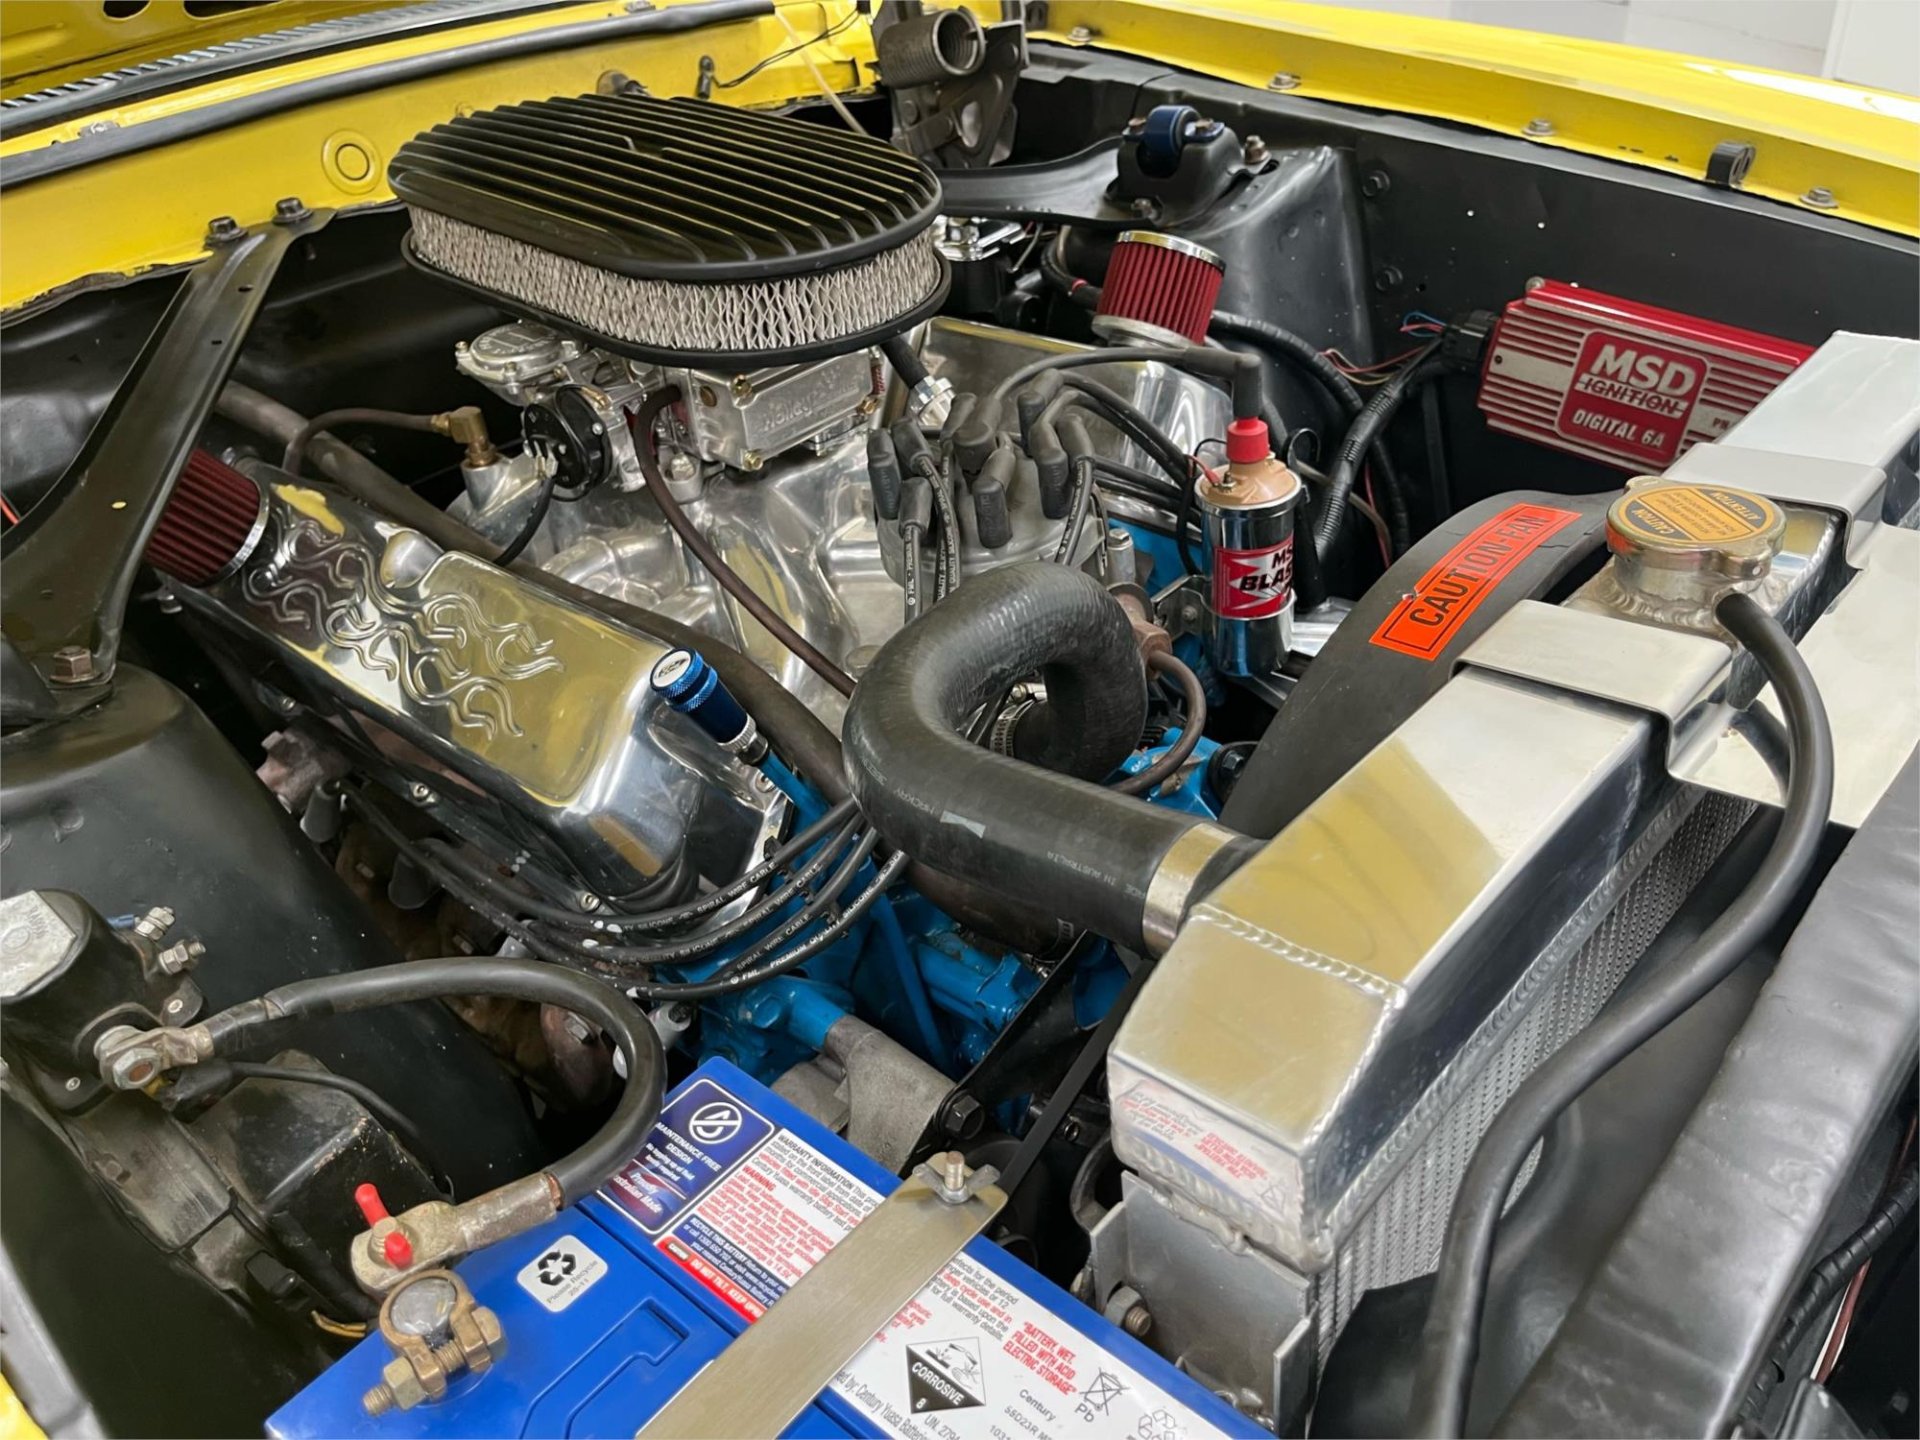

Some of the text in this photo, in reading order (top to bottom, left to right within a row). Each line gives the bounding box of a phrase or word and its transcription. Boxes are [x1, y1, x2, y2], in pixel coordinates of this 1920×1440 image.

[1590, 343, 1696, 397] MSD
[1582, 376, 1681, 416] IGNITION
[1572, 408, 1665, 449] DIGITAL 6A
[1631, 508, 1675, 535] CAUTION
[1408, 515, 1551, 627] CAUTION-FAN
[796, 861, 823, 887] CABLE
[1046, 851, 1103, 878] AUSTRALIA
[697, 896, 725, 913] SPIRAL
[727, 880, 748, 896] WIRE
[749, 860, 778, 884] CABLE
[736, 949, 763, 971] SPIRAL
[785, 913, 812, 935] CABLE
[742, 969, 761, 981] FML
[770, 944, 807, 969] PREMIUM
[842, 885, 875, 918] SILICONE
[655, 1122, 721, 1172] MAINTENANCE FREE
[665, 1143, 693, 1164] DESIGN
[776, 1133, 867, 1200] WARRANTY INFORMATION This
[733, 1172, 750, 1185] Lead
[741, 1164, 776, 1191] WARNING
[763, 1145, 787, 1163] months
[783, 1160, 795, 1169] for
[792, 1166, 828, 1193] commercial
[786, 1152, 798, 1161] on
[794, 1157, 808, 1168] the
[804, 1164, 822, 1178] front
[818, 1174, 837, 1188] label
[833, 1184, 851, 1198] from
[848, 1195, 865, 1207] date
[612, 1174, 662, 1213] ustralian Made
[749, 1156, 775, 1176] Century
[786, 1183, 815, 1205] warranty
[811, 1201, 835, 1219] battery
[831, 1215, 847, 1228] test
[687, 1216, 780, 1288] RECYCLE THIS BATTERY Return to your
[689, 1241, 703, 1253] your
[695, 1234, 711, 1247] 1300
[688, 1258, 702, 1270] DO
[697, 1265, 715, 1280] NOT
[727, 1288, 748, 1304] KEEP
[940, 1272, 1014, 1324] deep cycle use and in
[960, 1274, 1010, 1309] vehicles or 12
[971, 1270, 1019, 1305] for the period
[938, 1292, 953, 1304] full
[949, 1300, 982, 1324] warranty
[948, 1288, 1010, 1332] is based upon the
[1000, 1339, 1040, 1370] ELECTRIC
[1009, 1330, 1078, 1381] FILLED WITH ACID
[835, 1371, 849, 1385] ed
[856, 1380, 881, 1413] Century
[880, 1404, 902, 1427] Yuasa
[911, 1361, 965, 1406] CORROSIVE
[915, 1397, 927, 1410] 8
[1019, 1388, 1056, 1422] Century
[1074, 1403, 1095, 1423] Pb
